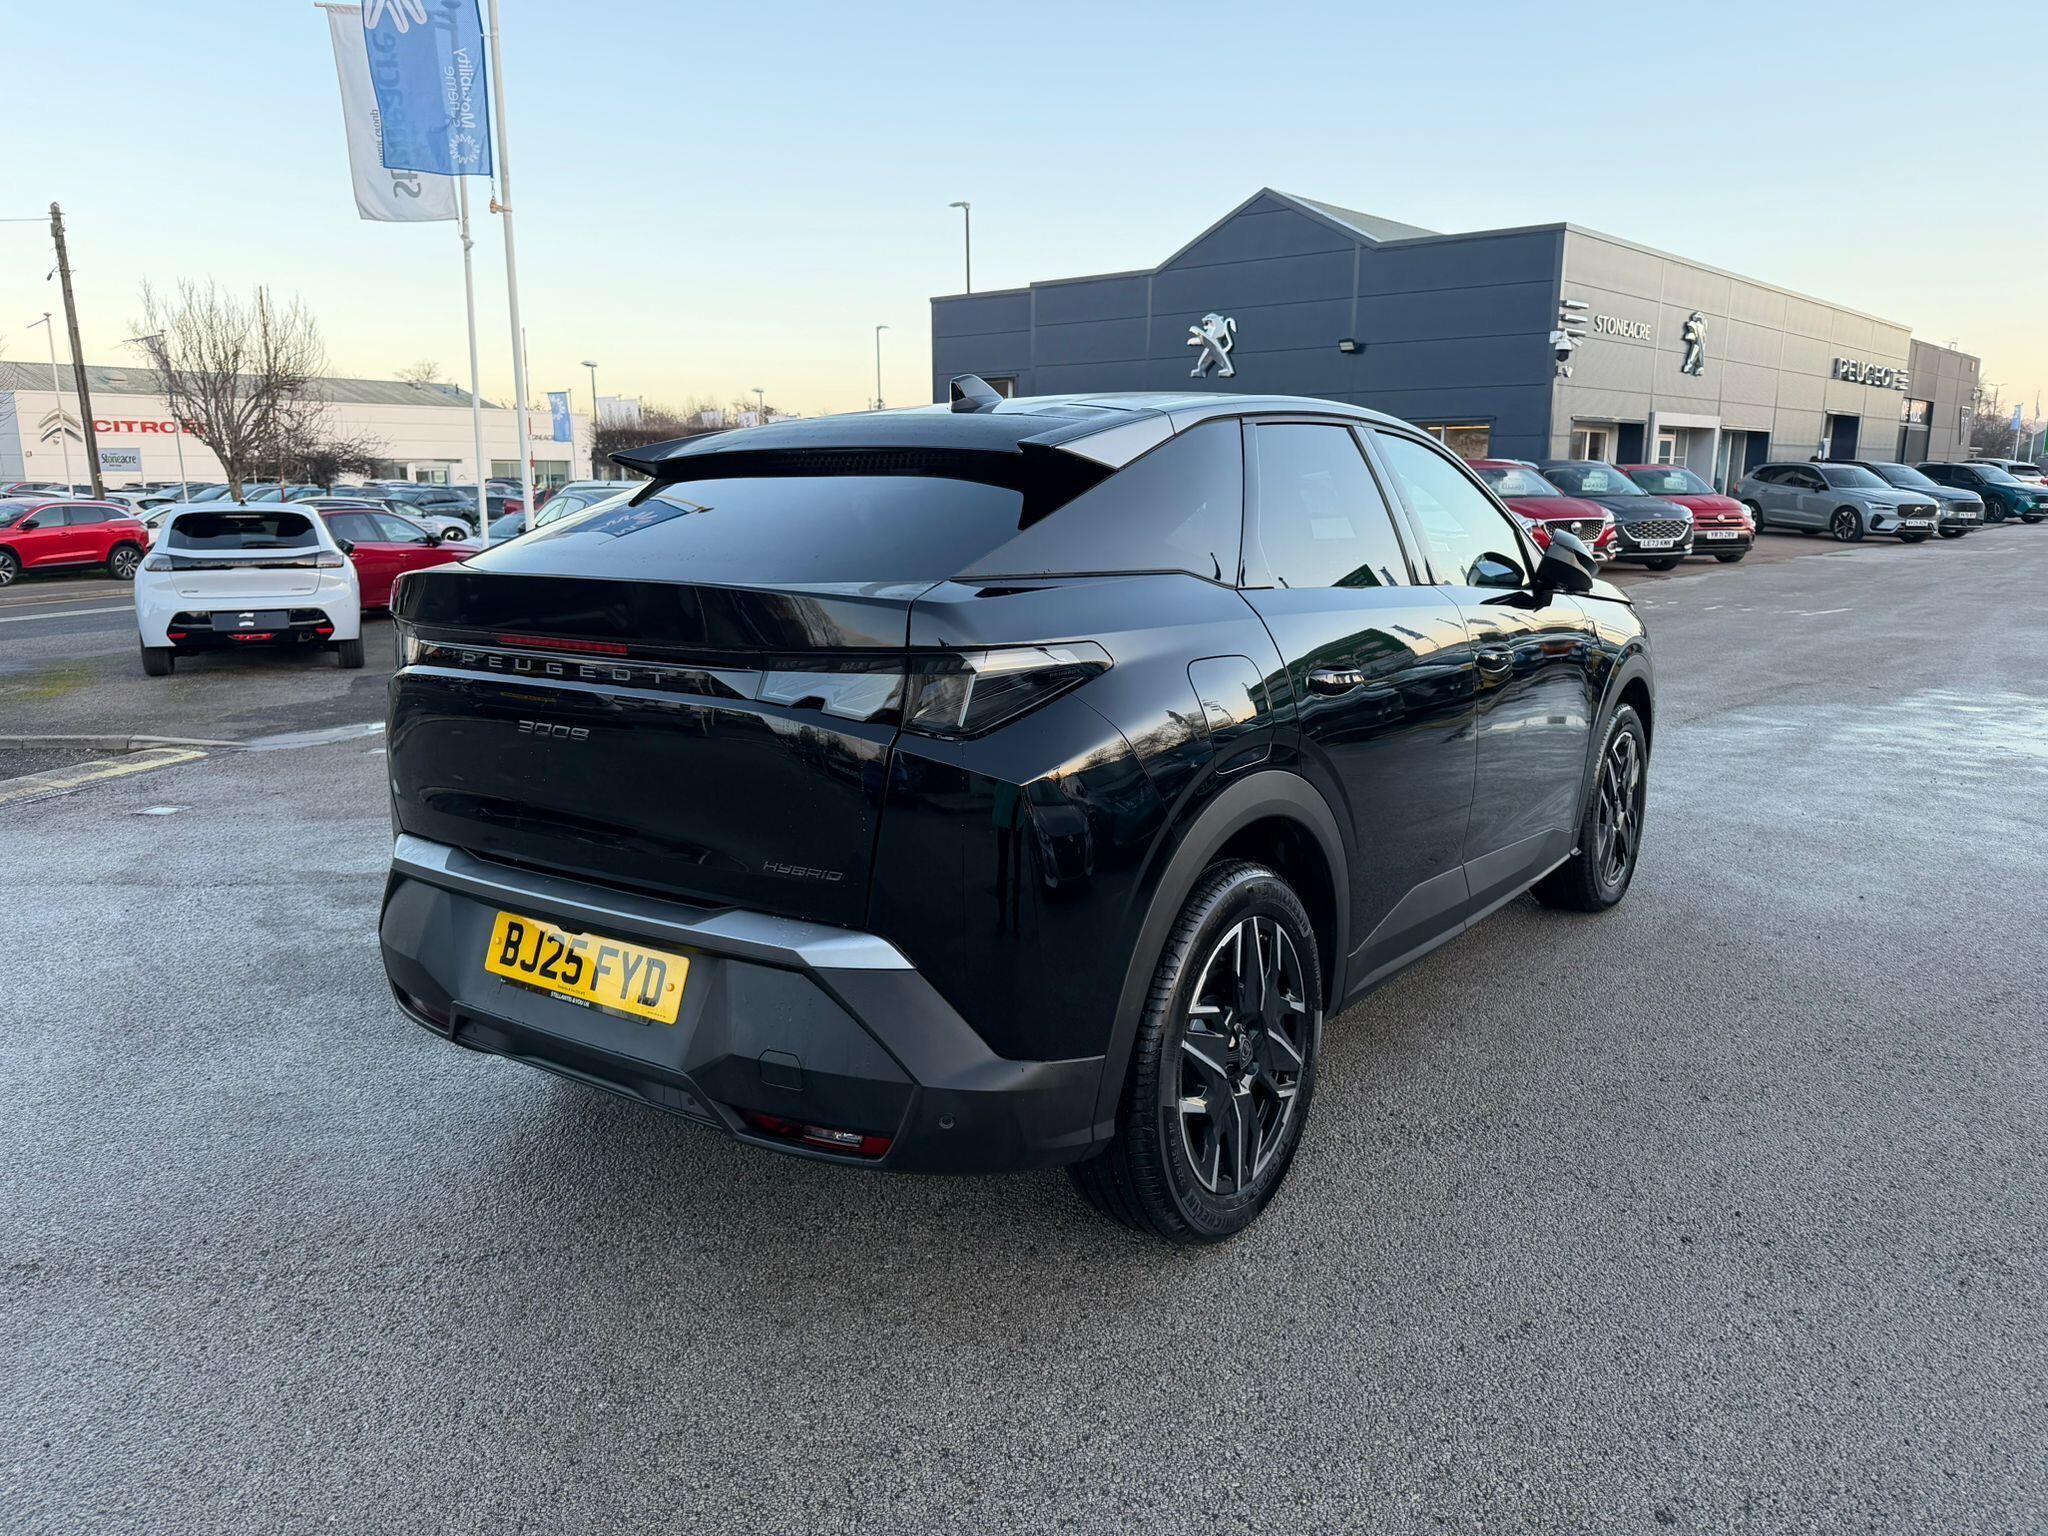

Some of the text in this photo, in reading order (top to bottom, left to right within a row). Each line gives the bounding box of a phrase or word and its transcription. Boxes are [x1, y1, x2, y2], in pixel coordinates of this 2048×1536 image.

[1594, 315, 1652, 341] STONEACRE
[1834, 357, 1898, 389] PEUGEOT
[93, 418, 207, 434] CITRO
[101, 453, 137, 464] Stoneacre
[461, 652, 667, 686] PEUGEOT
[518, 719, 591, 743] 3008
[762, 860, 844, 882] HYBRID
[499, 921, 667, 1008] BJ25 FYD
